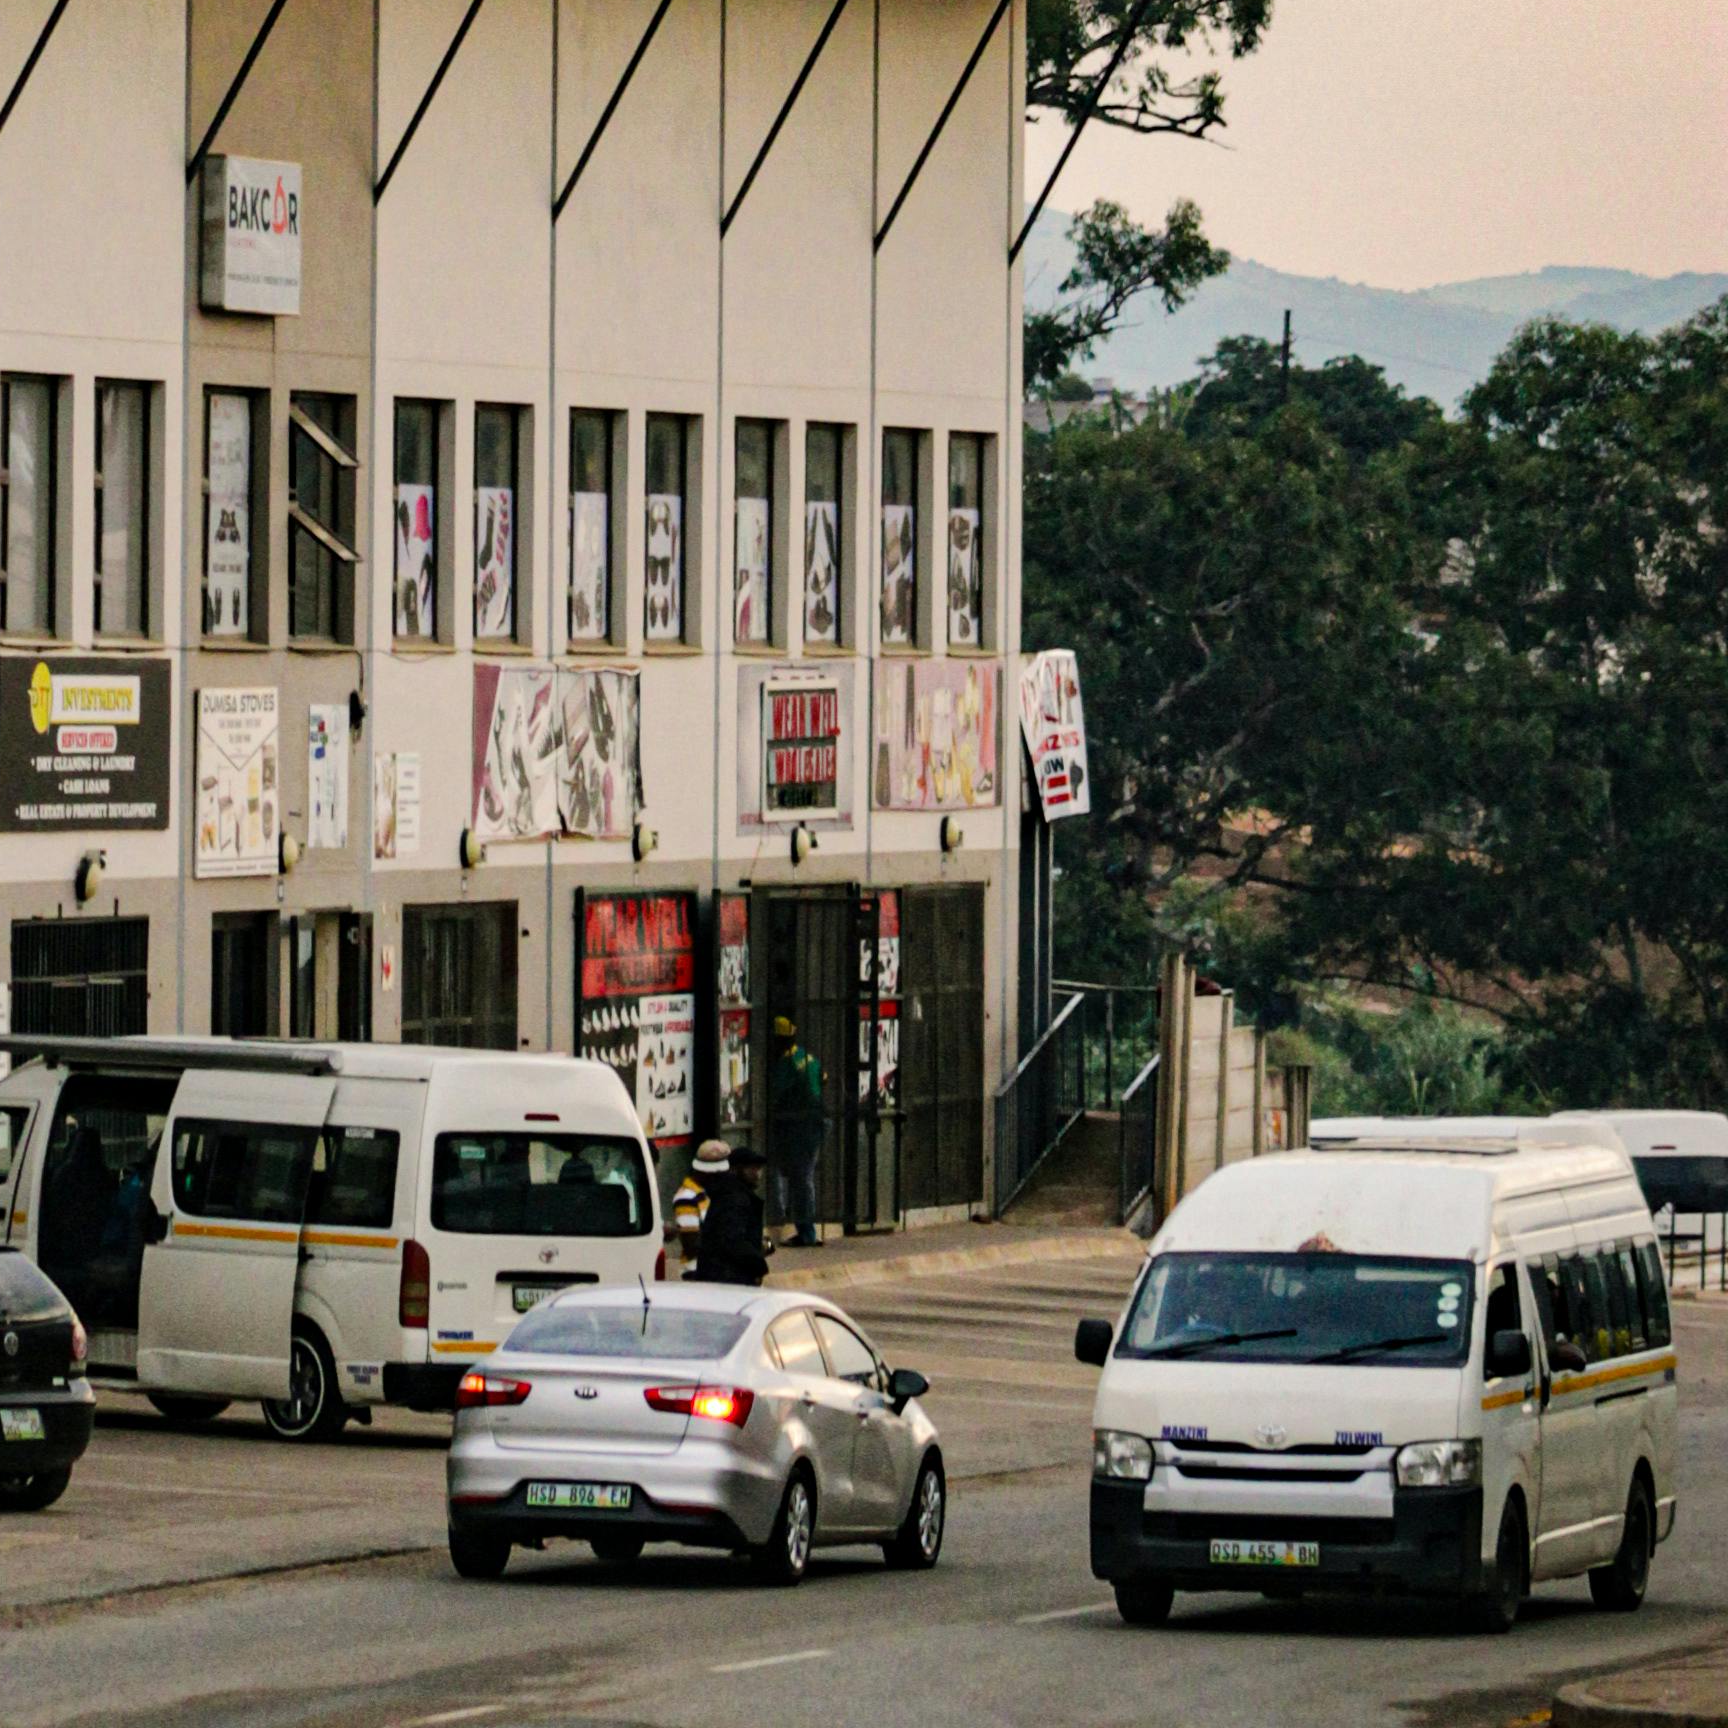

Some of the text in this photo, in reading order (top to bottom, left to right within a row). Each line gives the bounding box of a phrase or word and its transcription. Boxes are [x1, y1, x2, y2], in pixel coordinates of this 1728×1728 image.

[229, 176, 298, 236] BAKCOR
[62, 688, 133, 712] INVESTMENTS
[240, 694, 274, 712] STOVES
[772, 690, 841, 740] WEAR WELL
[36, 756, 53, 772] DRY
[54, 756, 91, 772] CLEANING
[100, 756, 135, 771] LAUNDRY
[64, 778, 110, 795] CASH LOANS
[19, 804, 39, 821] REAL
[73, 803, 107, 819] PROPERTY
[108, 802, 157, 818] DEVELOPMENT
[585, 896, 693, 956] WEAR WELL
[1161, 1425, 1208, 1441] MANZINI
[1335, 1430, 1384, 1446] ZULWINI
[529, 1484, 557, 1503] HSD
[569, 1485, 595, 1504] 896
[1248, 1543, 1276, 1562] 455
[1298, 1544, 1317, 1563] BH
